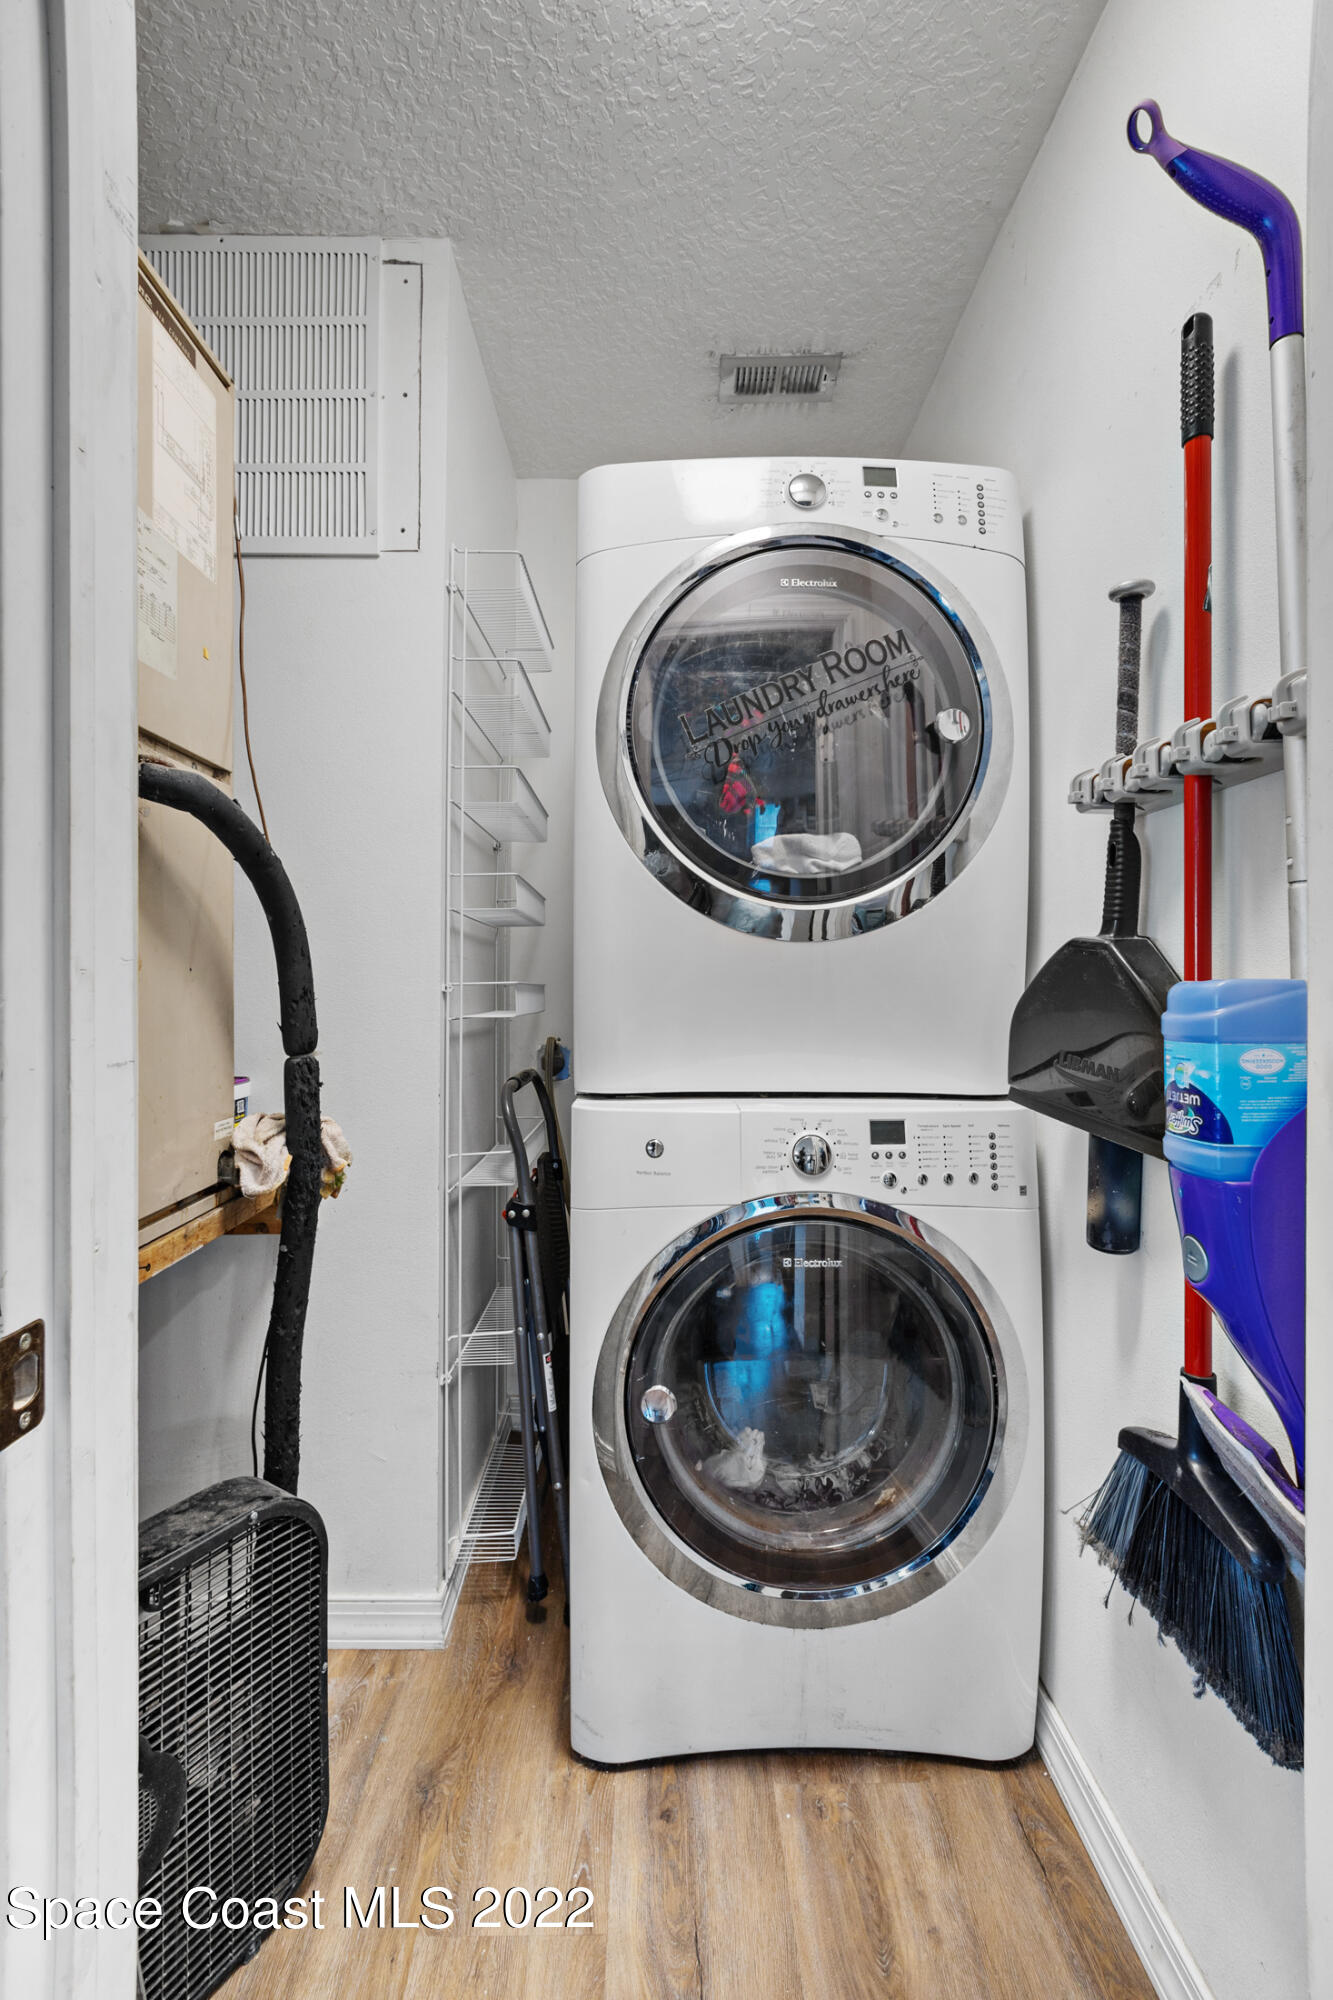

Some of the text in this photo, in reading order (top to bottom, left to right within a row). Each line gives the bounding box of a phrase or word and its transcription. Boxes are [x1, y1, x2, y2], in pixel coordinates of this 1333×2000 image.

[791, 578, 838, 588] Electrolux
[679, 629, 914, 745] LAUNDRY ROOM
[704, 734, 766, 768] Drop
[816, 683, 881, 719] drawers
[880, 665, 921, 693] here
[1057, 1050, 1121, 1081] LIBMAN
[794, 1257, 843, 1268] Electrolux
